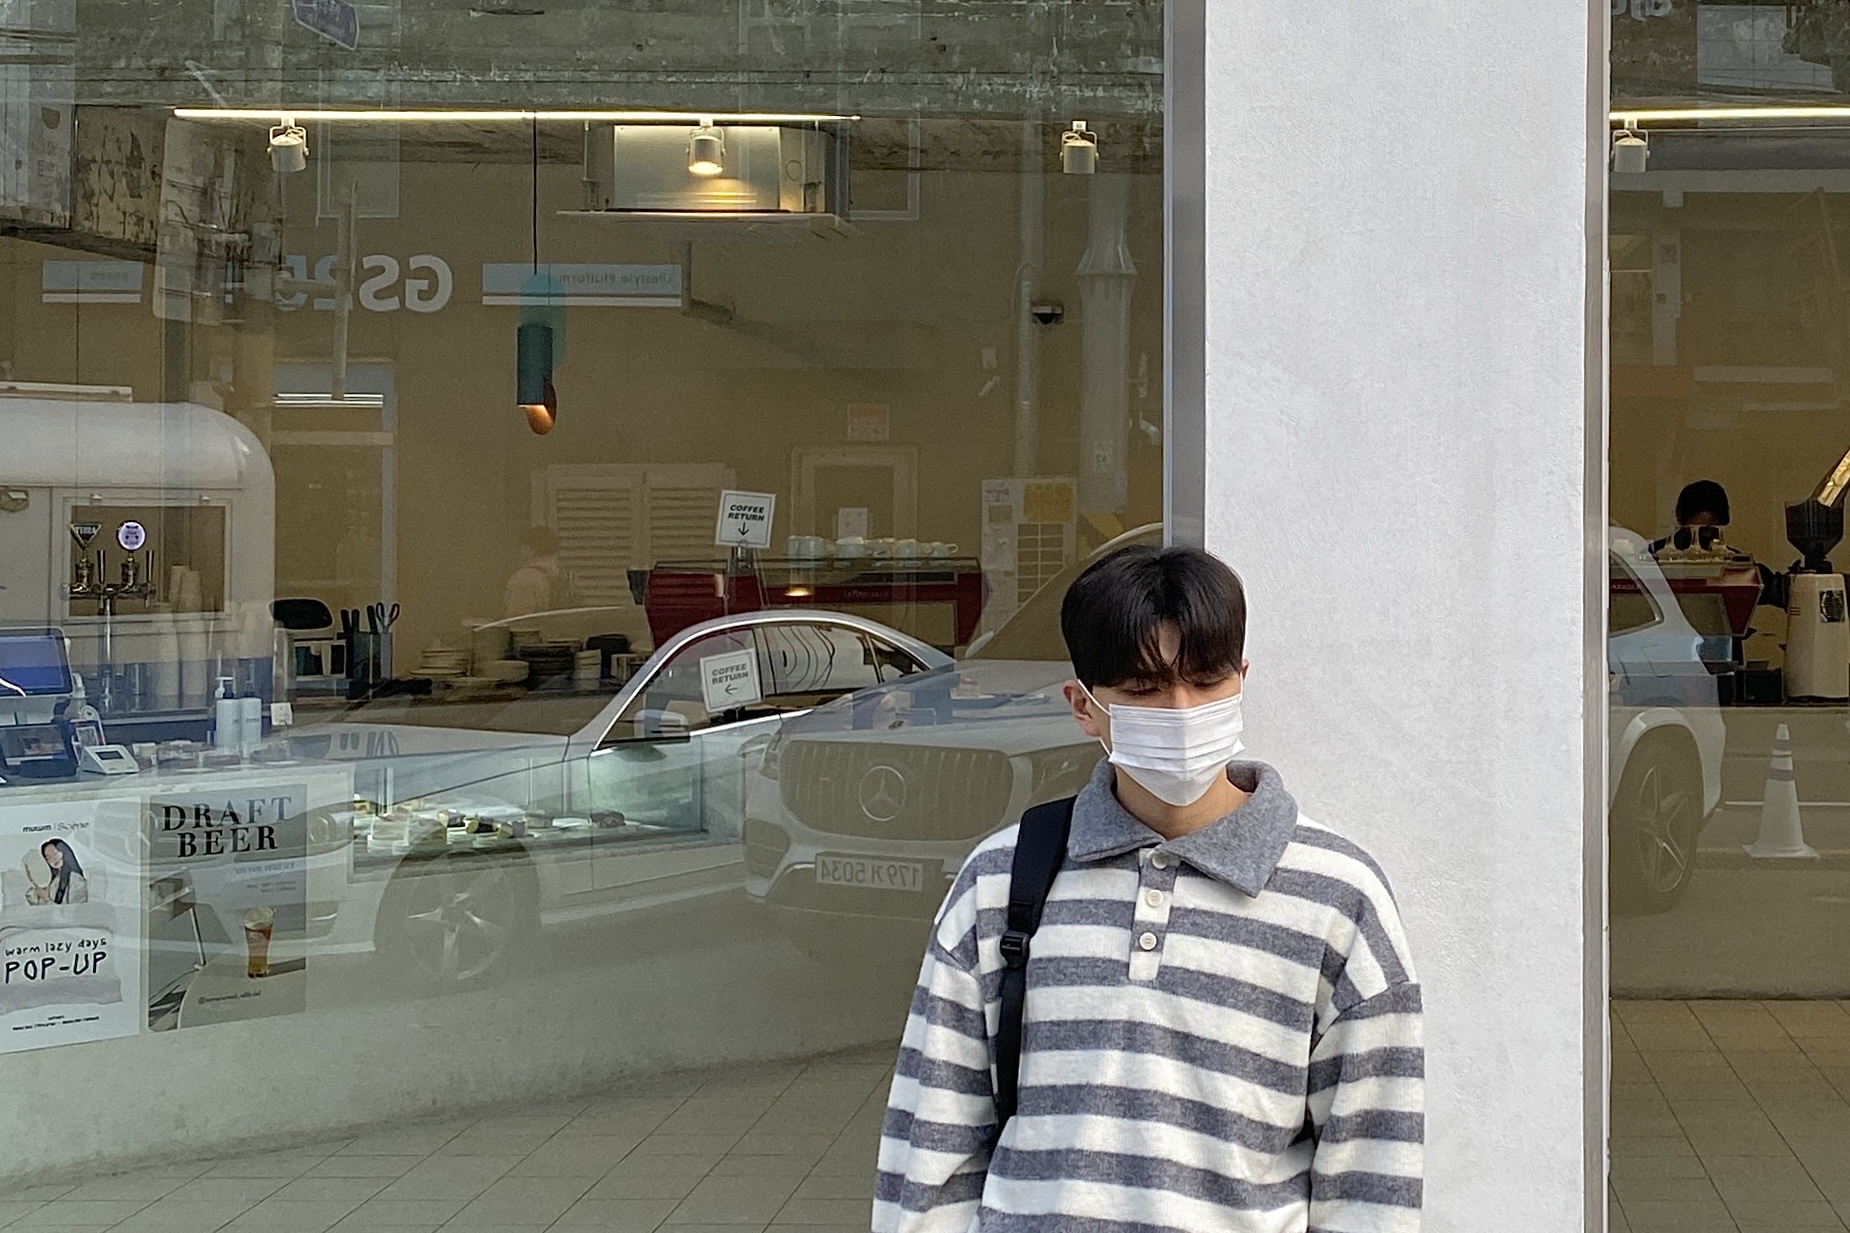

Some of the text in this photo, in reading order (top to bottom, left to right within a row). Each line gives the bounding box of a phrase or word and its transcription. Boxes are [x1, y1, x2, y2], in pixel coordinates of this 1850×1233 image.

[727, 512, 765, 522] RETURN
[730, 504, 765, 514] COFFEE
[711, 663, 748, 677] COFFEE
[711, 671, 749, 685] RETURN
[161, 796, 292, 832] DRAFT
[176, 825, 278, 858] BEER
[5, 938, 107, 956] warm lazy days
[5, 951, 107, 984] POP-UP
